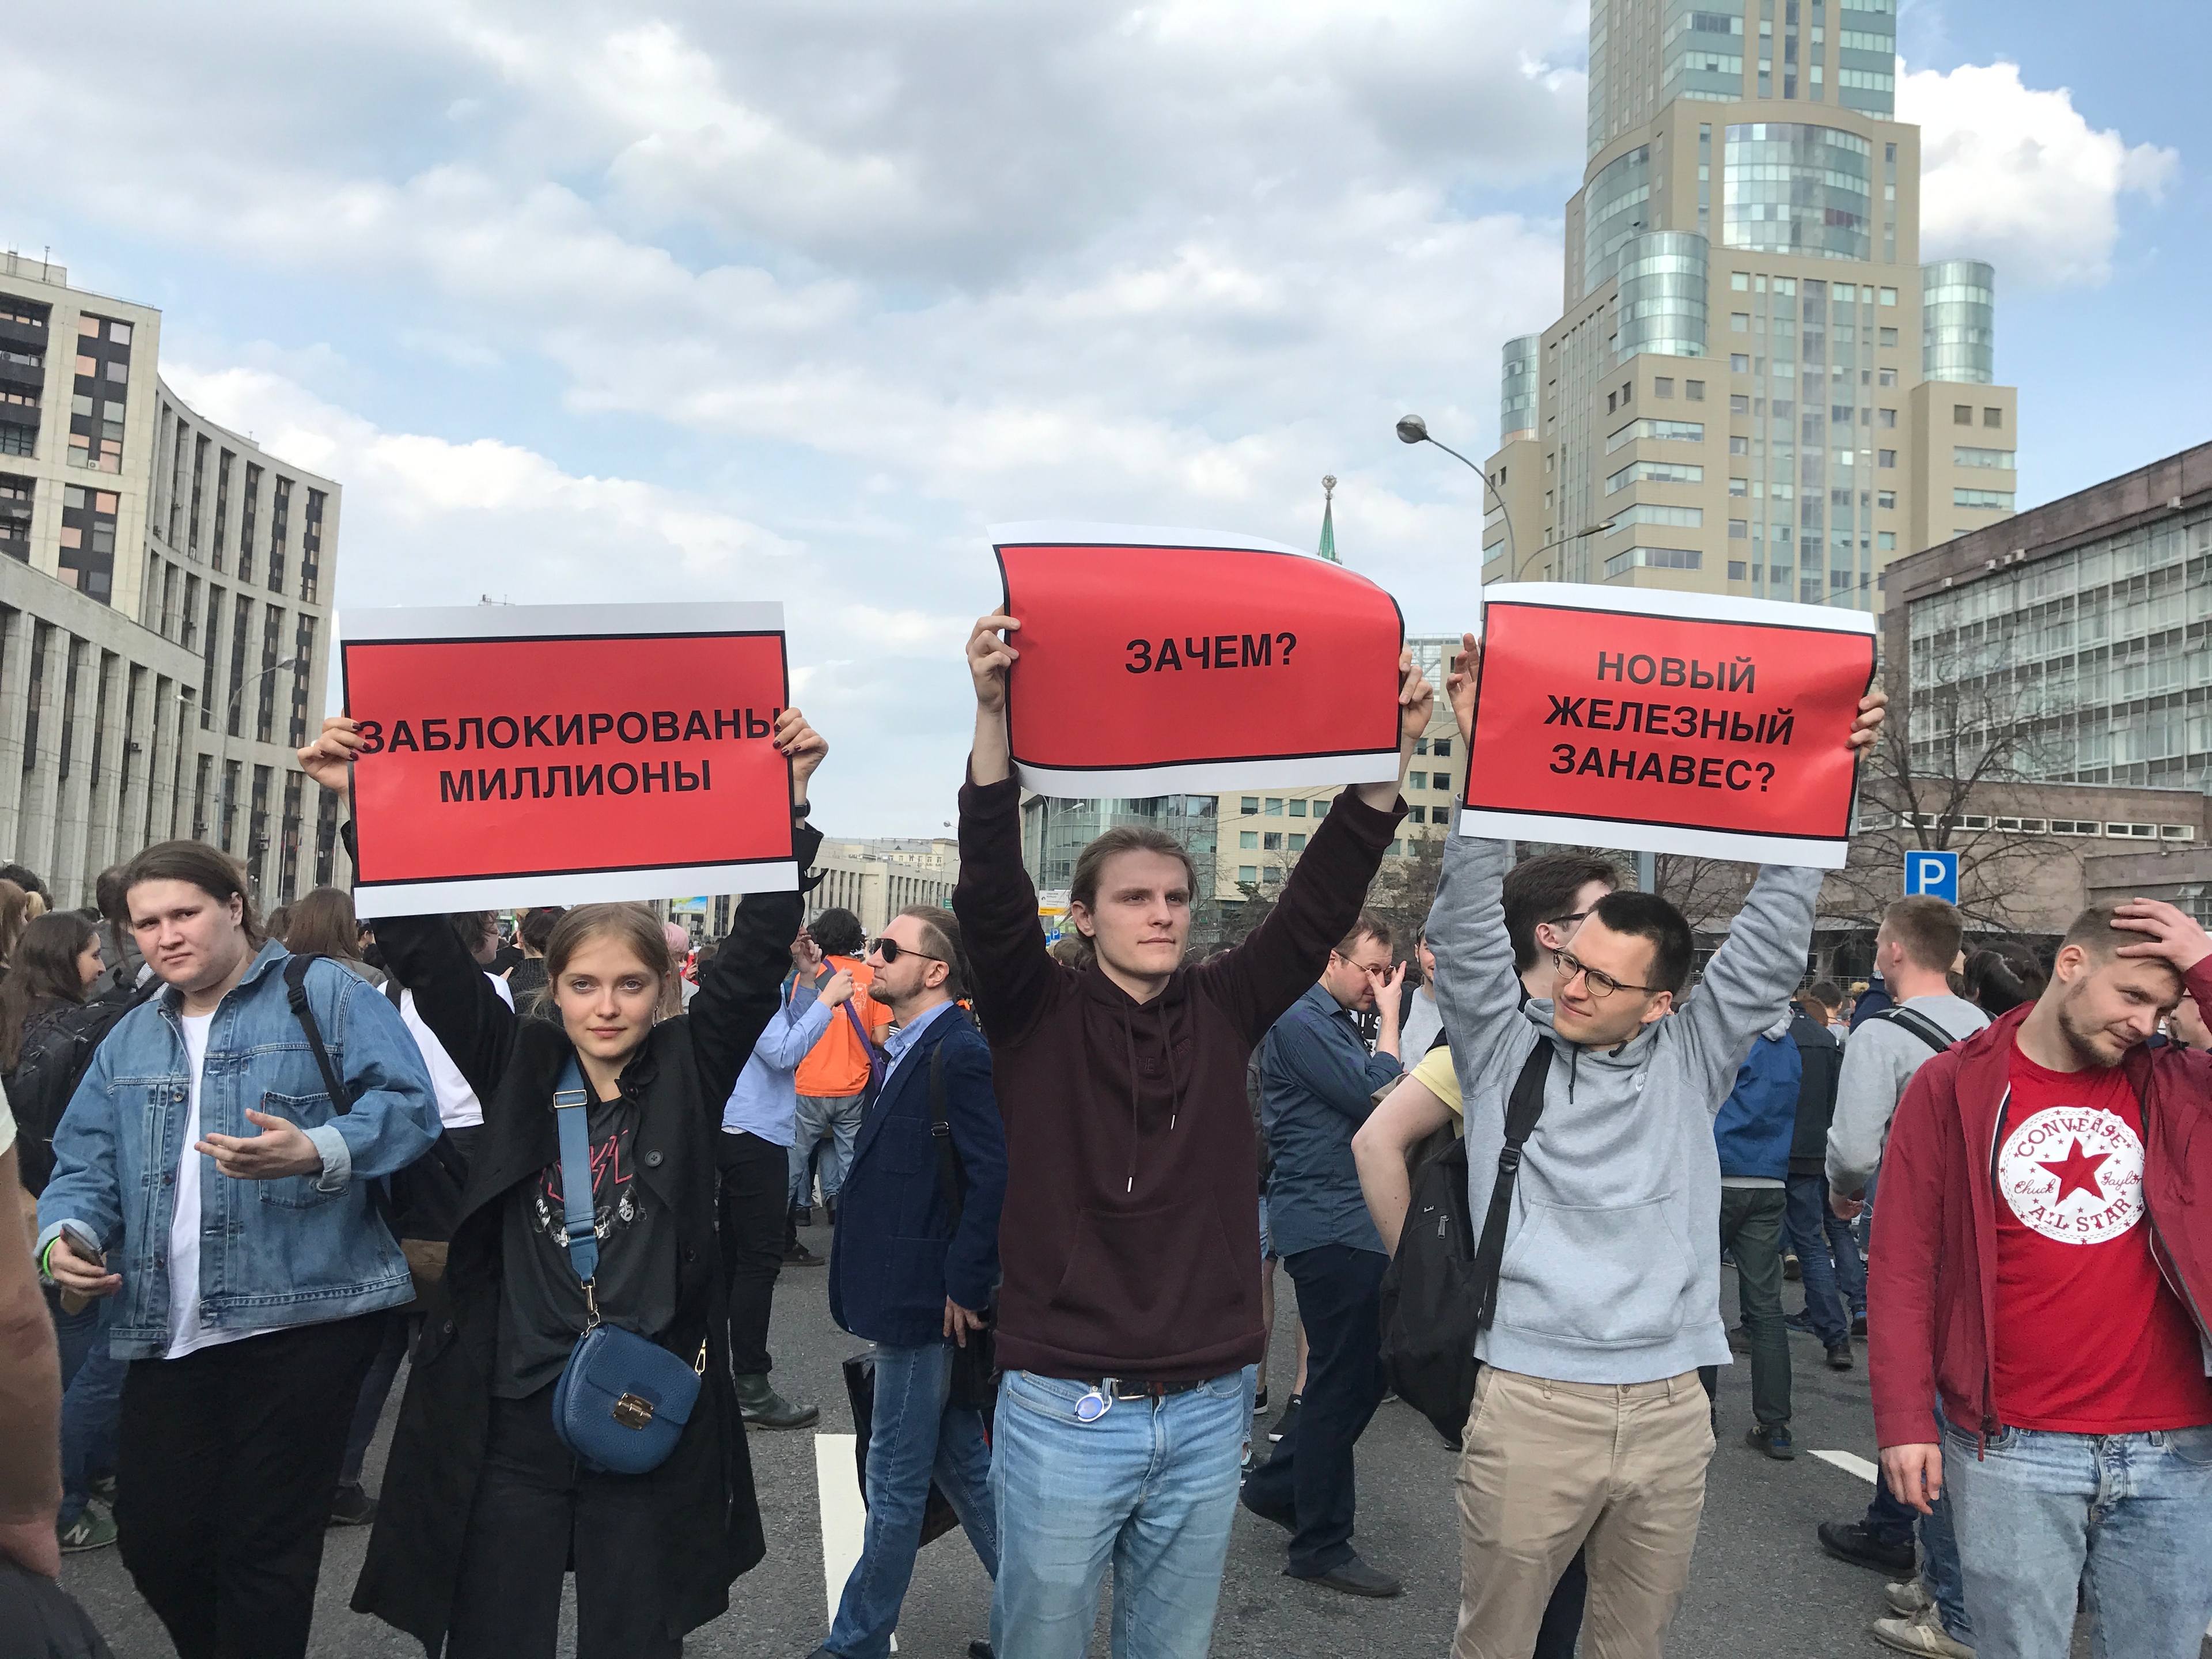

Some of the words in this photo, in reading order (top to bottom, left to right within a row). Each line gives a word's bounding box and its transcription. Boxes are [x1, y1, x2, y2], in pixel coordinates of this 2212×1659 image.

[1125, 632, 1297, 674] ЗАЧЕМ?
[1598, 652, 1755, 694] НОВЫЙ
[358, 707, 781, 754] ЗАБЛОКИРОВАНЫ
[1544, 695, 1795, 745] ЖЕЛЕЗНЫЙ
[440, 760, 711, 802] МИЛЛИОНЫ
[1550, 744, 1775, 792] ЗАНАВЕС?
[1919, 858, 1946, 895] P
[2017, 1118, 2127, 1157] CONVERSE
[2014, 1179, 2056, 1195] Chuck
[2028, 1205, 2067, 1230] ALL
[2076, 1198, 2132, 1232] STAR
